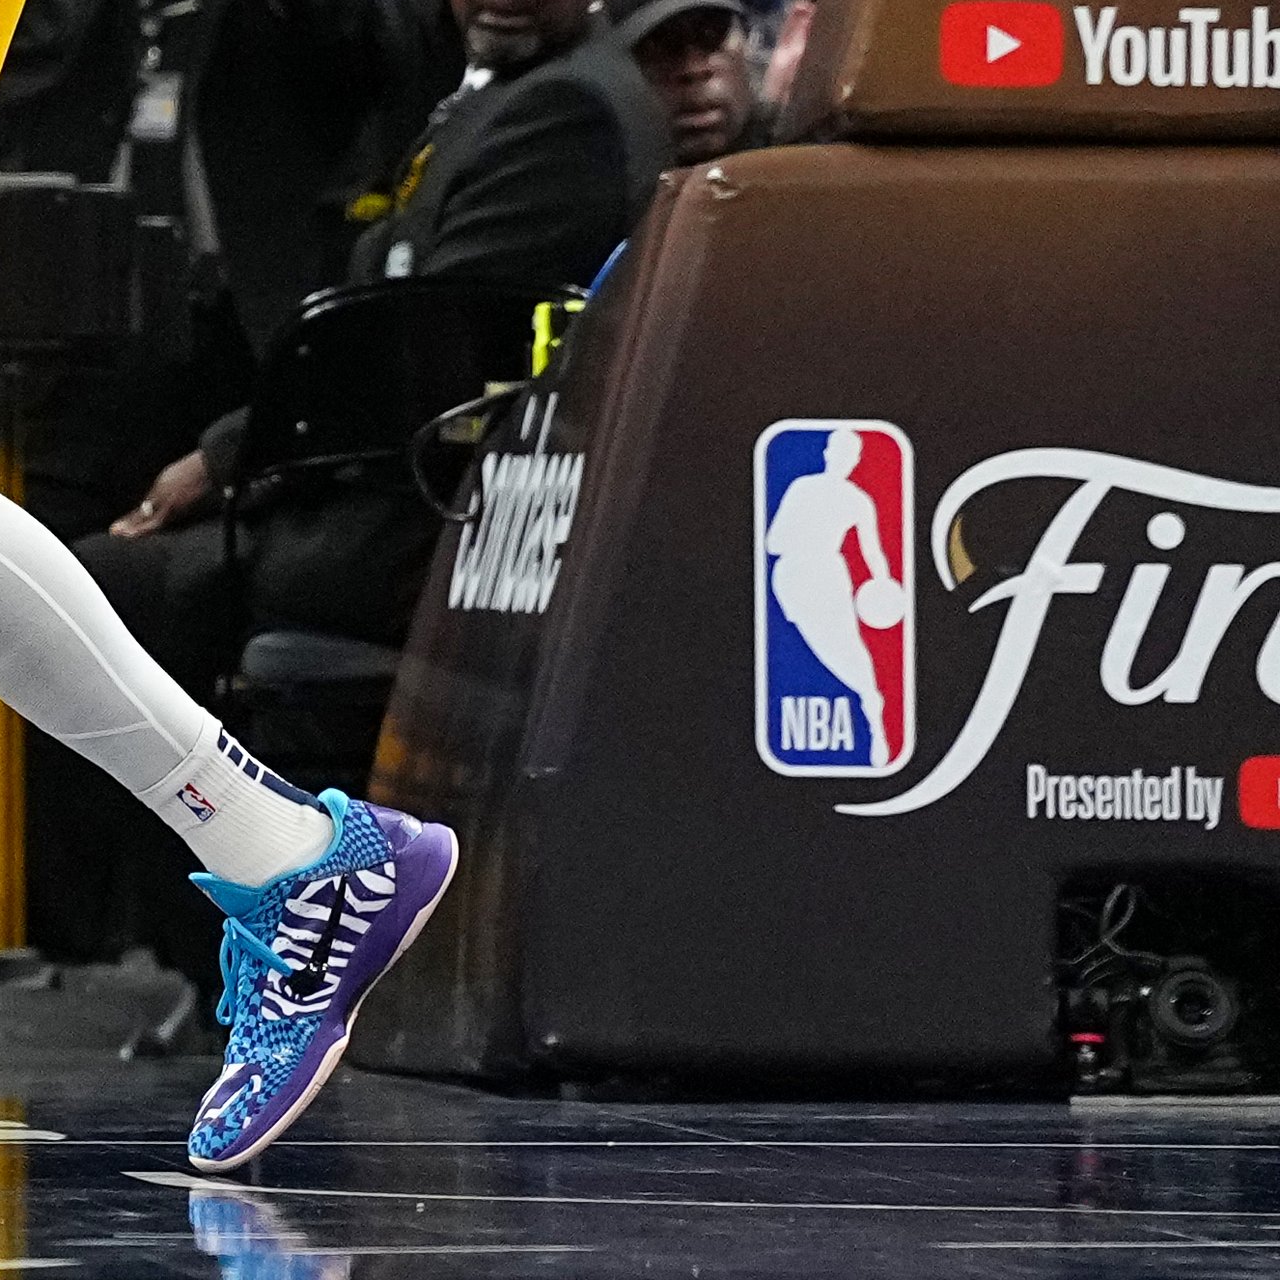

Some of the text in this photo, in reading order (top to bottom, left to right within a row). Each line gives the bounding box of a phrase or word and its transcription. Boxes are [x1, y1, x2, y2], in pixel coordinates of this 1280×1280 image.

[1072, 5, 1280, 89] YouTub
[834, 447, 1280, 817] Fin
[781, 695, 855, 752] NBA
[1026, 764, 1225, 831] Presented by
